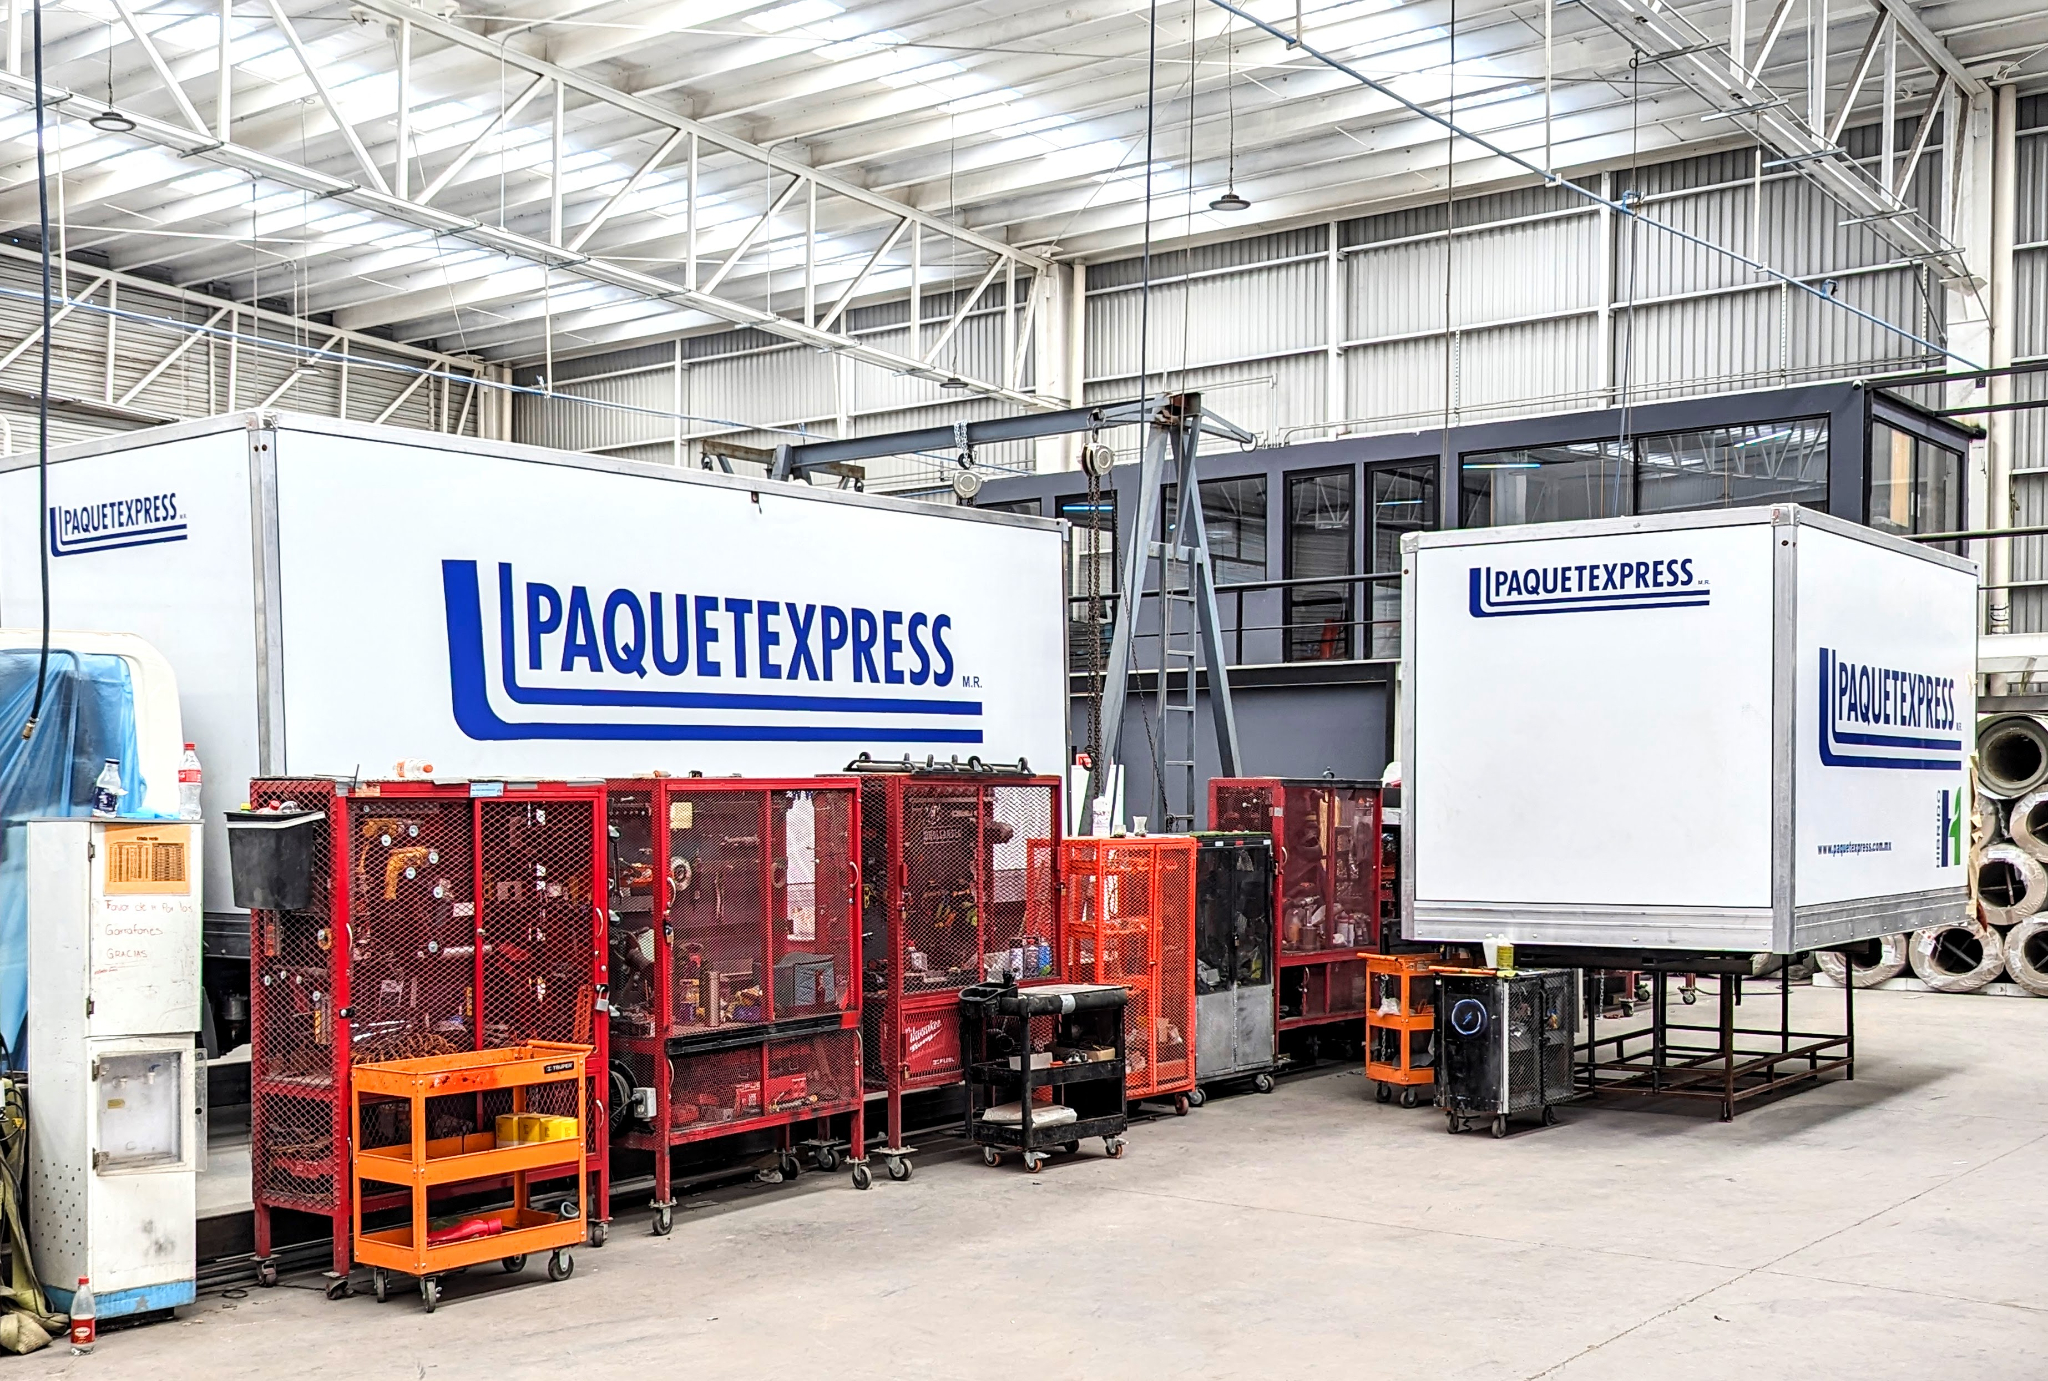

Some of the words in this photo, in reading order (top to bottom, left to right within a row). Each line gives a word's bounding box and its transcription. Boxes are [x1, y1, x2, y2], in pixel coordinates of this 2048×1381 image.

[64, 492, 178, 536] PAQUETEXPRESS
[1494, 558, 1694, 598] PAQUETEXPRESS
[526, 581, 955, 688] PAQUETEXPRESS
[962, 675, 983, 689] M.R.
[1838, 661, 1955, 731] PAQUETEXPRESS
[1817, 841, 1892, 857] www.paquetexpress.com.mx
